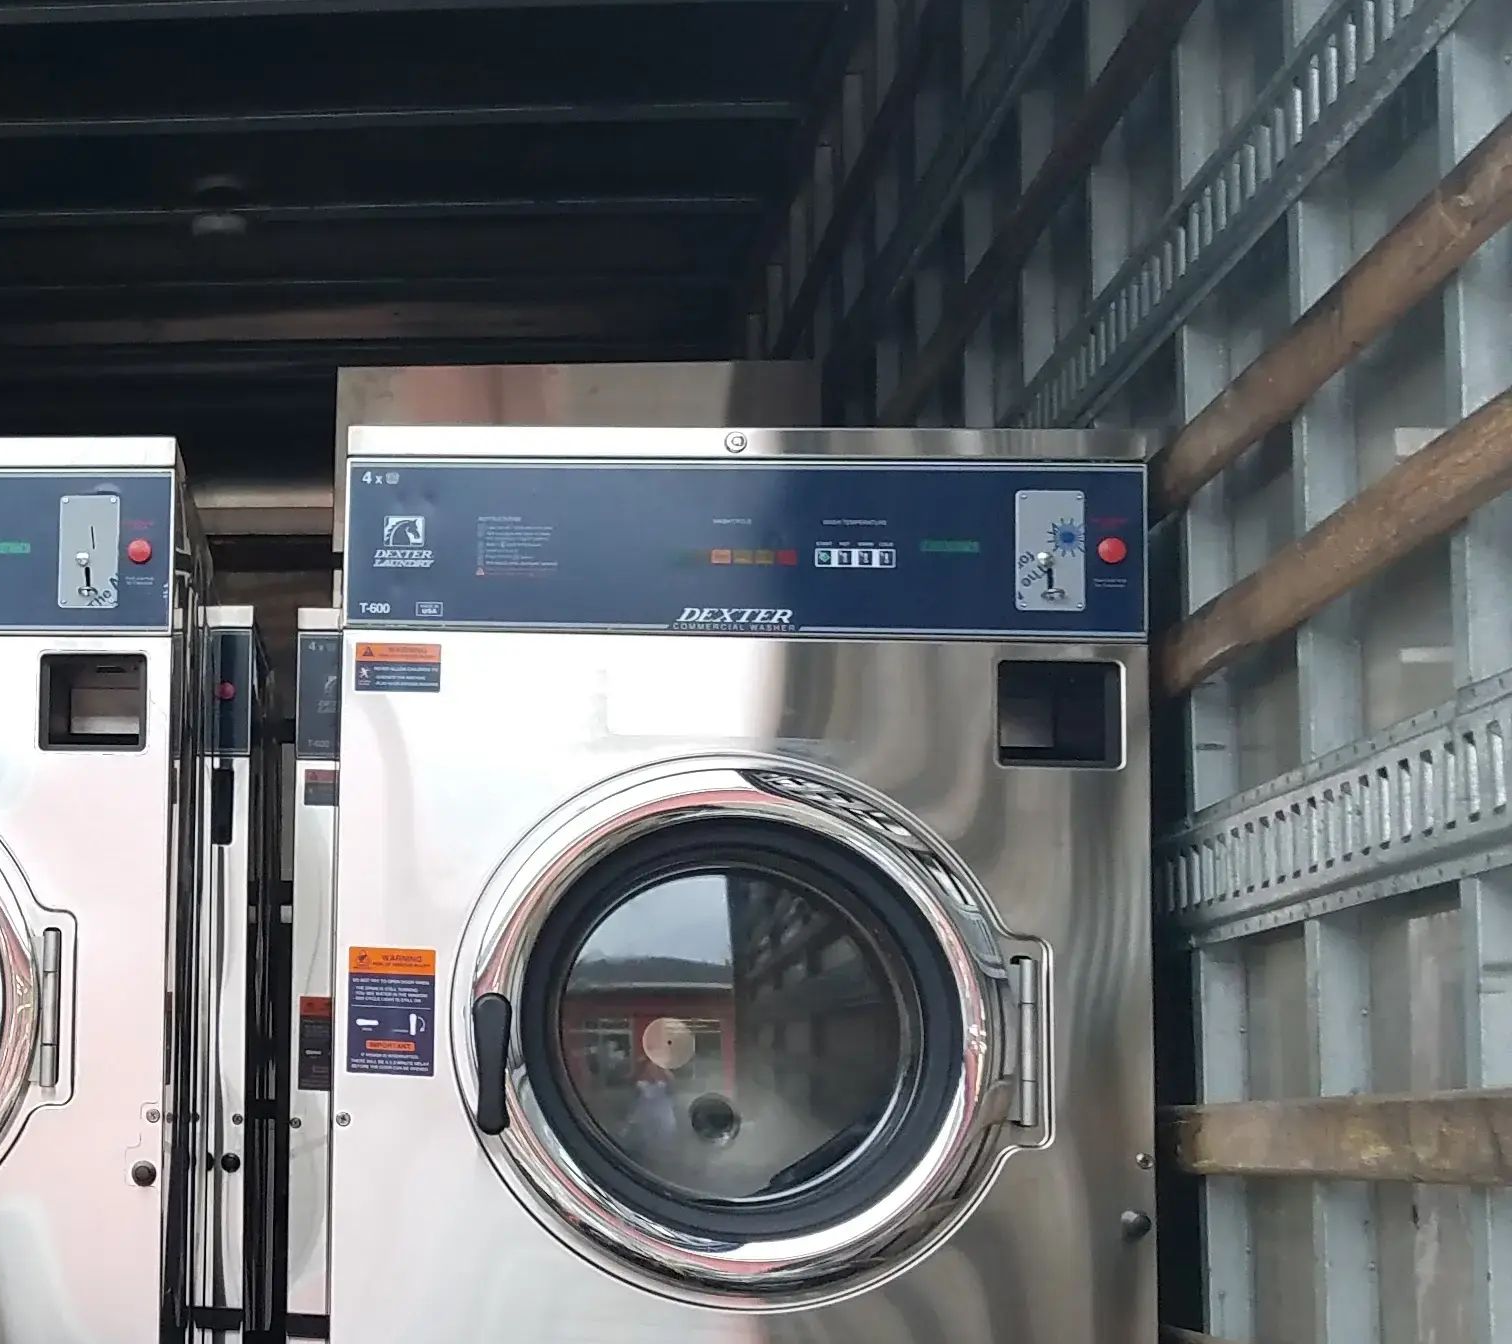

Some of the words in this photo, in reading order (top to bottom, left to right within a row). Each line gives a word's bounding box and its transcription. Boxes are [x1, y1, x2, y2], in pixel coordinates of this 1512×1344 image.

[361, 470, 372, 484] 4
[373, 548, 434, 559] DEXTER
[372, 559, 436, 568] LAUNDRY
[359, 602, 391, 614] T-600
[675, 607, 793, 624] DEXTER
[672, 622, 745, 631] COMMERCIAL
[749, 624, 796, 632] WASHER
